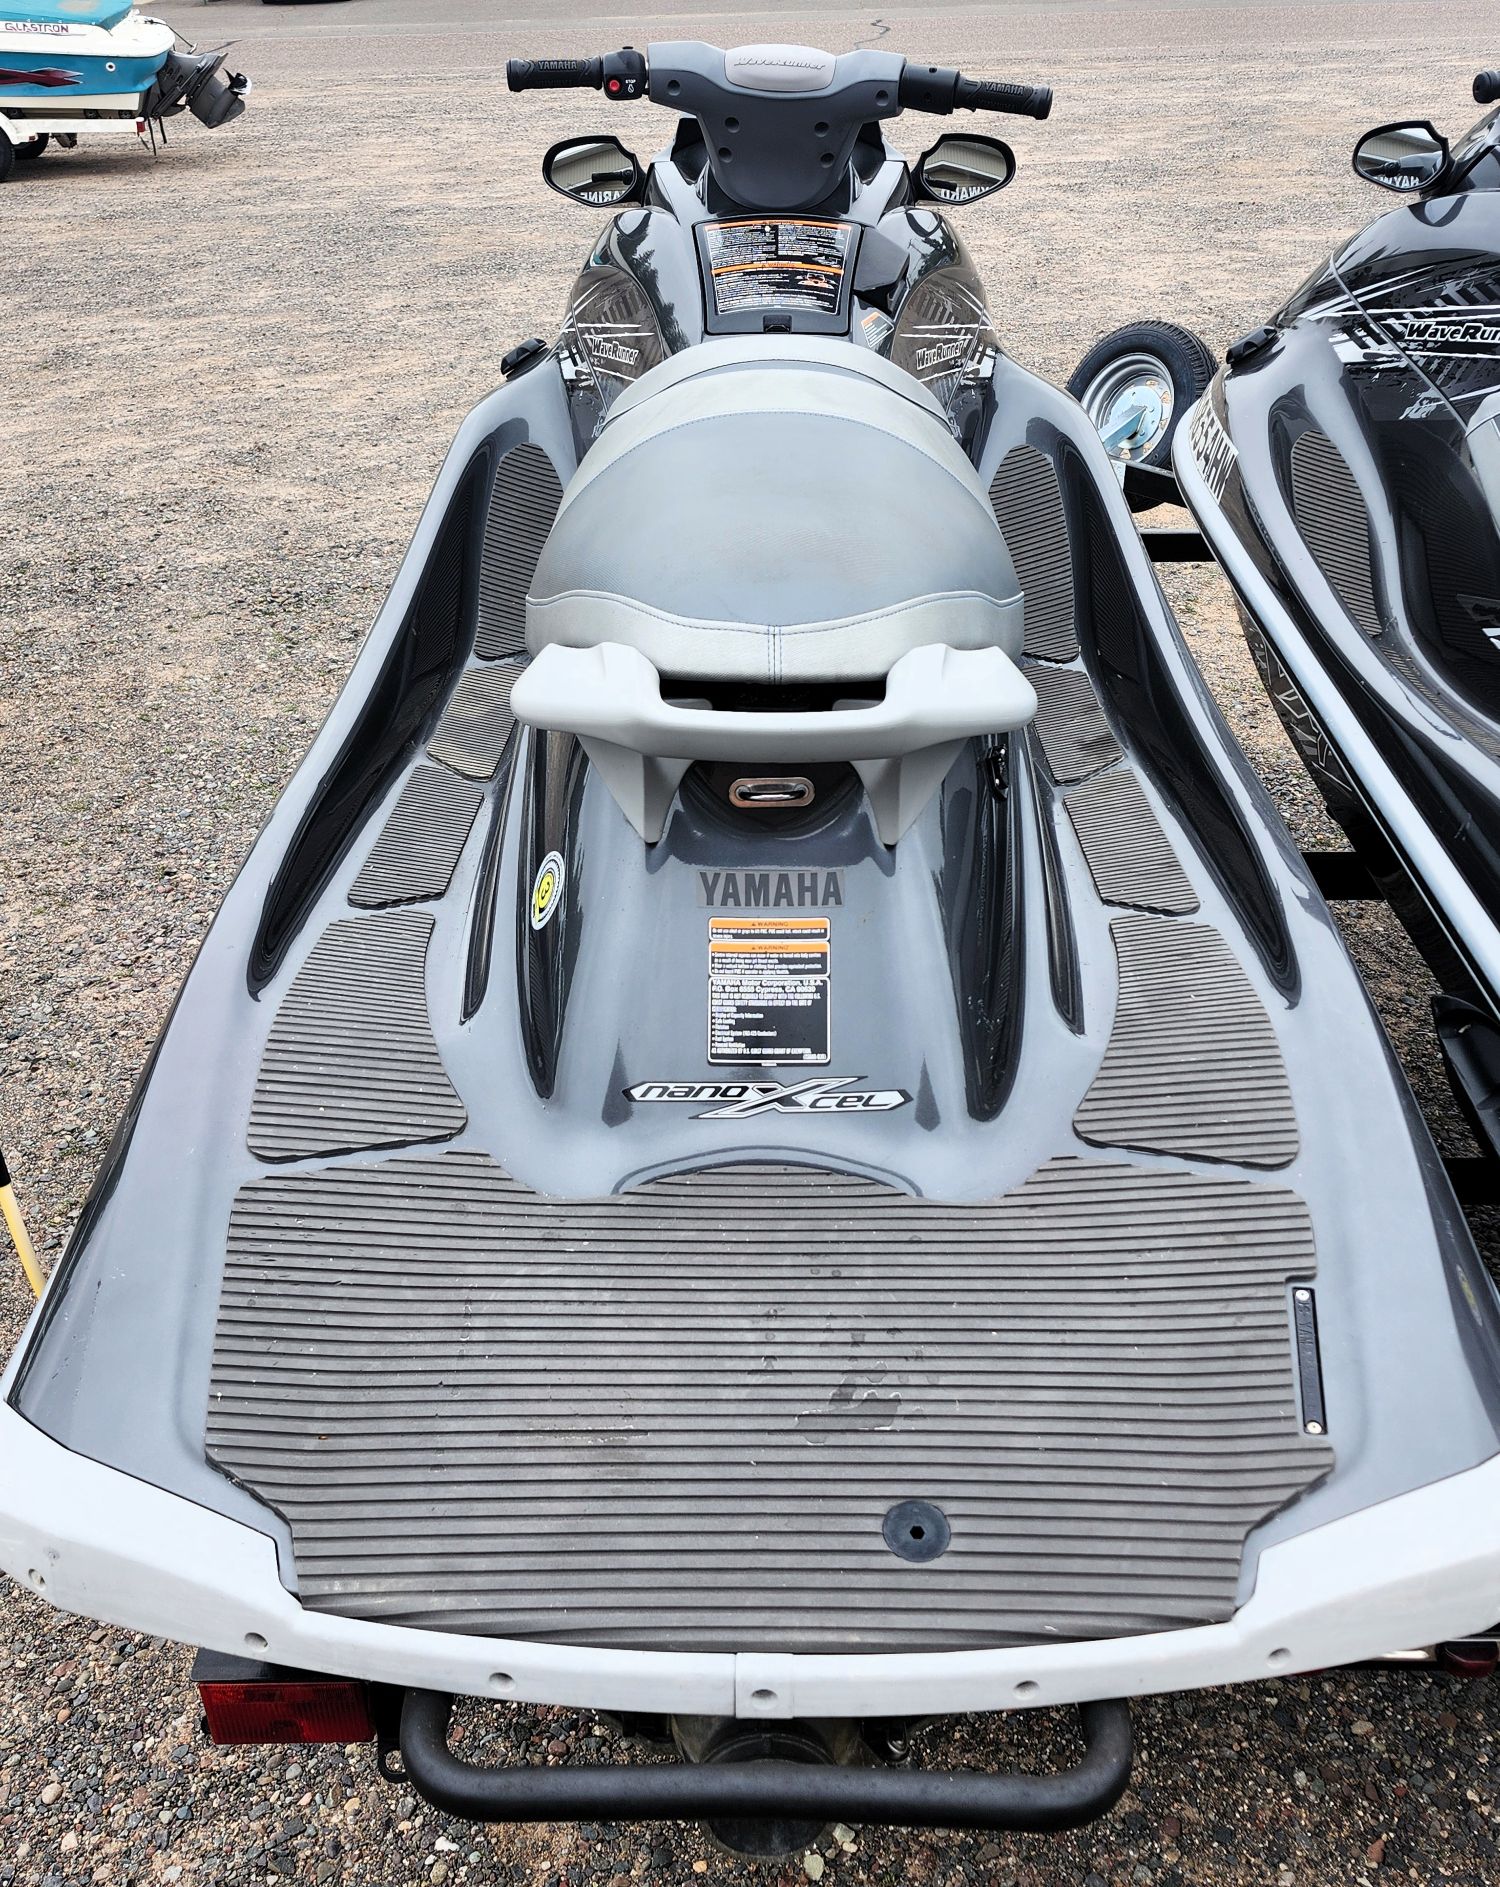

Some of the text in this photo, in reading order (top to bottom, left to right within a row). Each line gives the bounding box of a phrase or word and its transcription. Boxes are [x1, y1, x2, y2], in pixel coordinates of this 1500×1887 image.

[4, 22, 69, 33] GLASTRON
[538, 60, 578, 71] YAMAHA
[985, 82, 1024, 95] YAMAHA
[593, 337, 640, 365] WaveRunner
[916, 340, 965, 370] WaveRunner
[700, 872, 843, 907] YAMAHA
